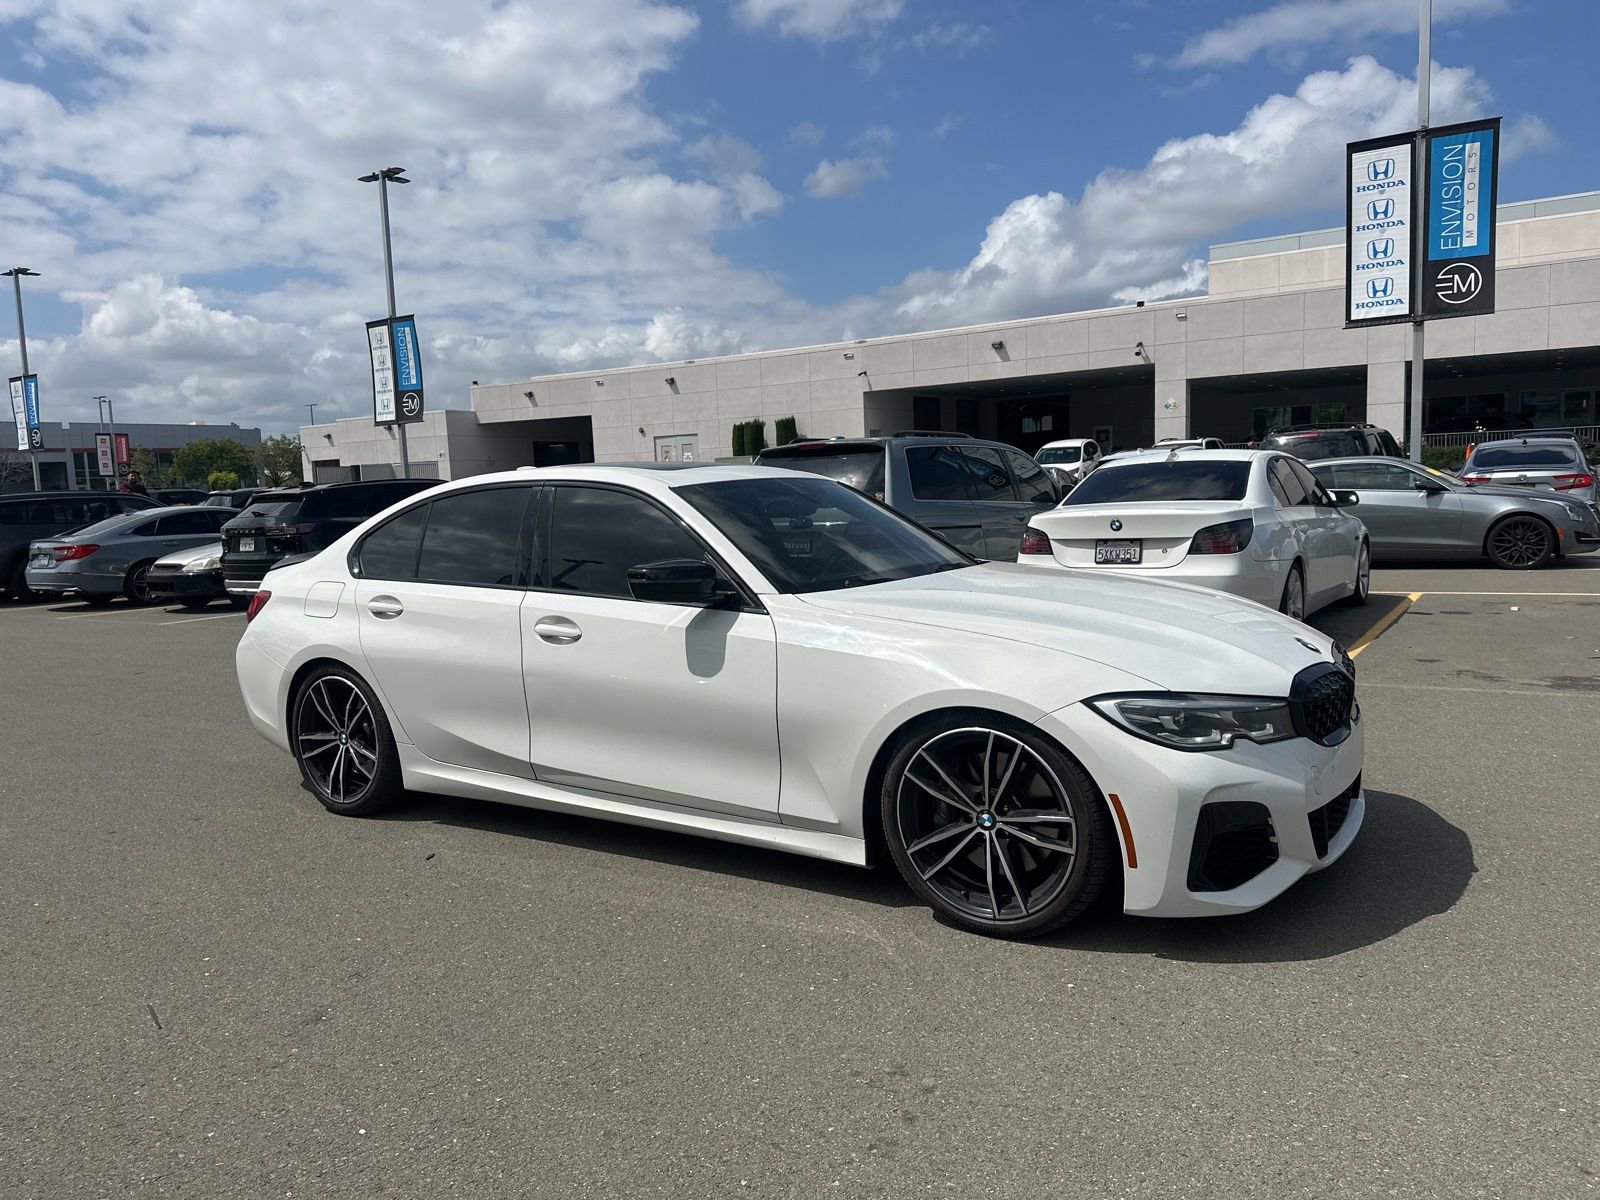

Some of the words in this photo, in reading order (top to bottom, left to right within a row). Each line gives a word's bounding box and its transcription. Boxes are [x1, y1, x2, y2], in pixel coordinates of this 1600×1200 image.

[1356, 180, 1406, 193] HONDA
[1441, 144, 1463, 250] ENVISION
[1465, 151, 1477, 239] MOTORS
[1355, 220, 1406, 232] HONDA
[1355, 259, 1405, 271] HONDA
[1355, 298, 1404, 309] HONDA
[398, 327, 410, 385] ENVISION
[1098, 549, 1137, 559] 5XKW351
